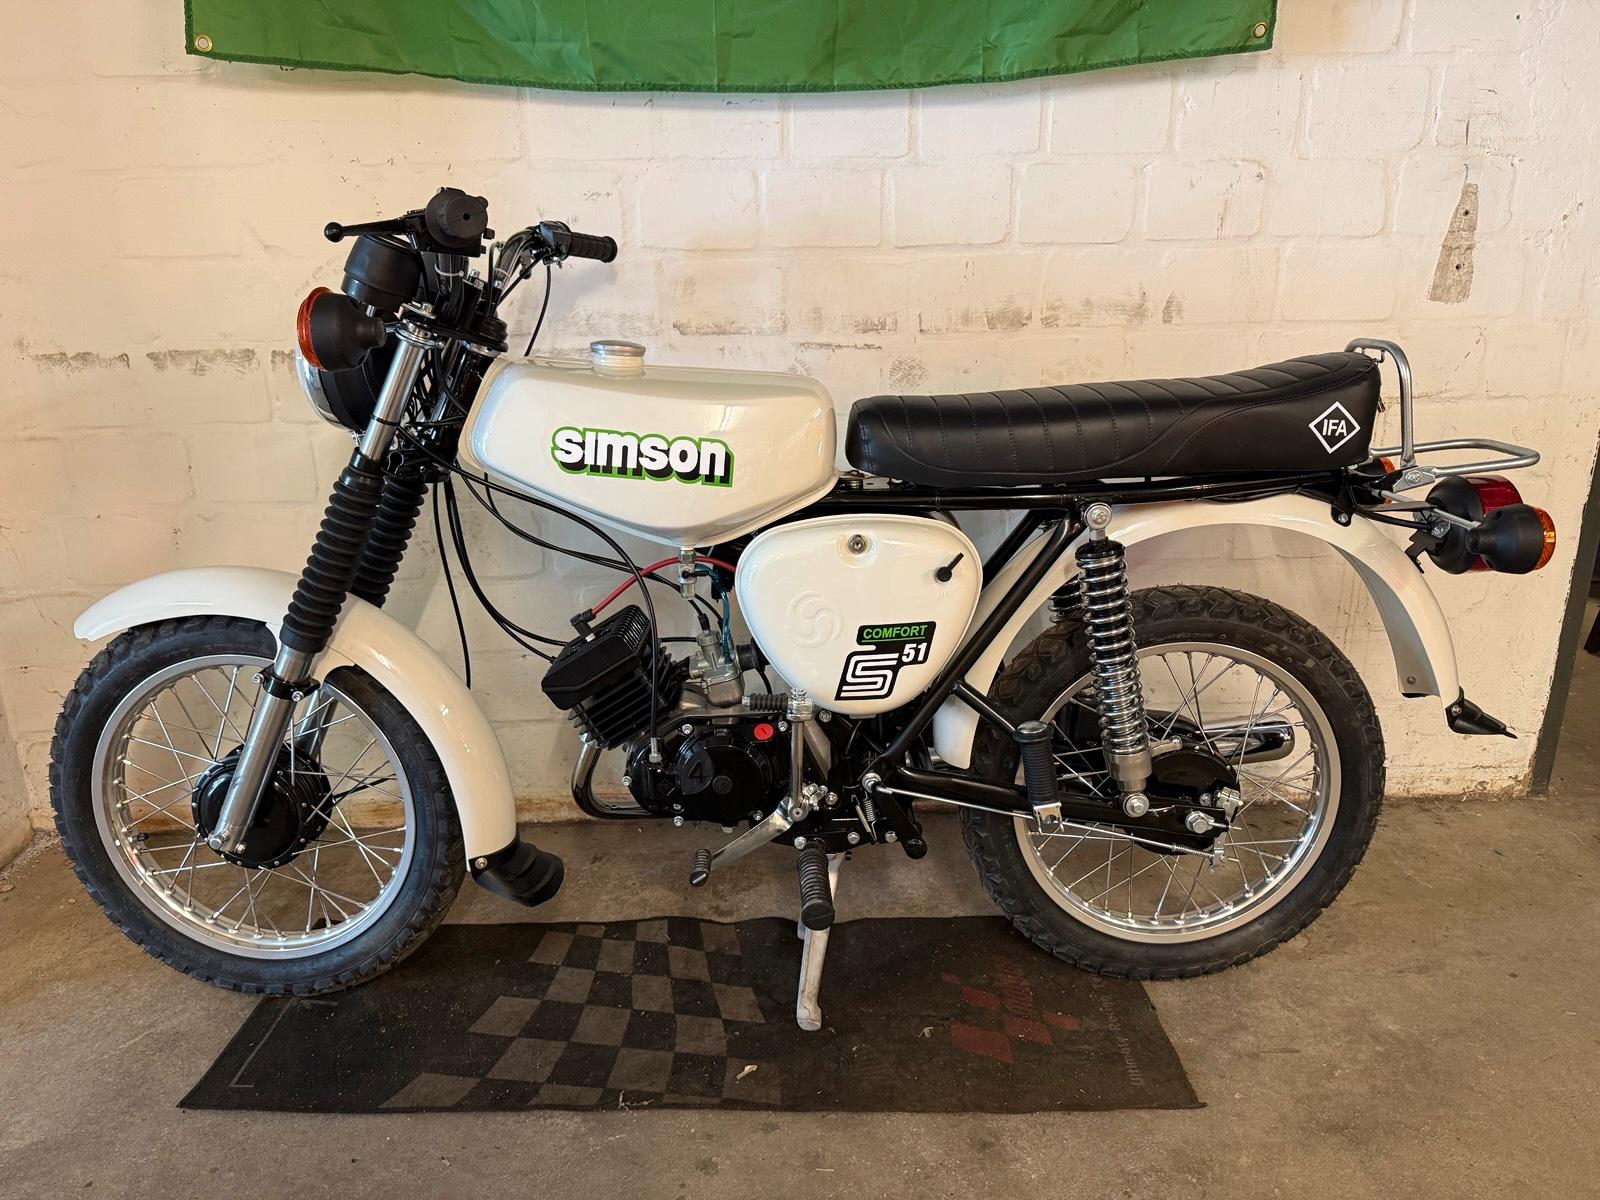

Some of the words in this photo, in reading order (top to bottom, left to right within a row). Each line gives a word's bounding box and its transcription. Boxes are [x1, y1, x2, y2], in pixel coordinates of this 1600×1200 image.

[1322, 418, 1347, 436] IFA
[553, 428, 733, 485] simson
[863, 625, 928, 639] COMFORT
[901, 642, 928, 663] 51
